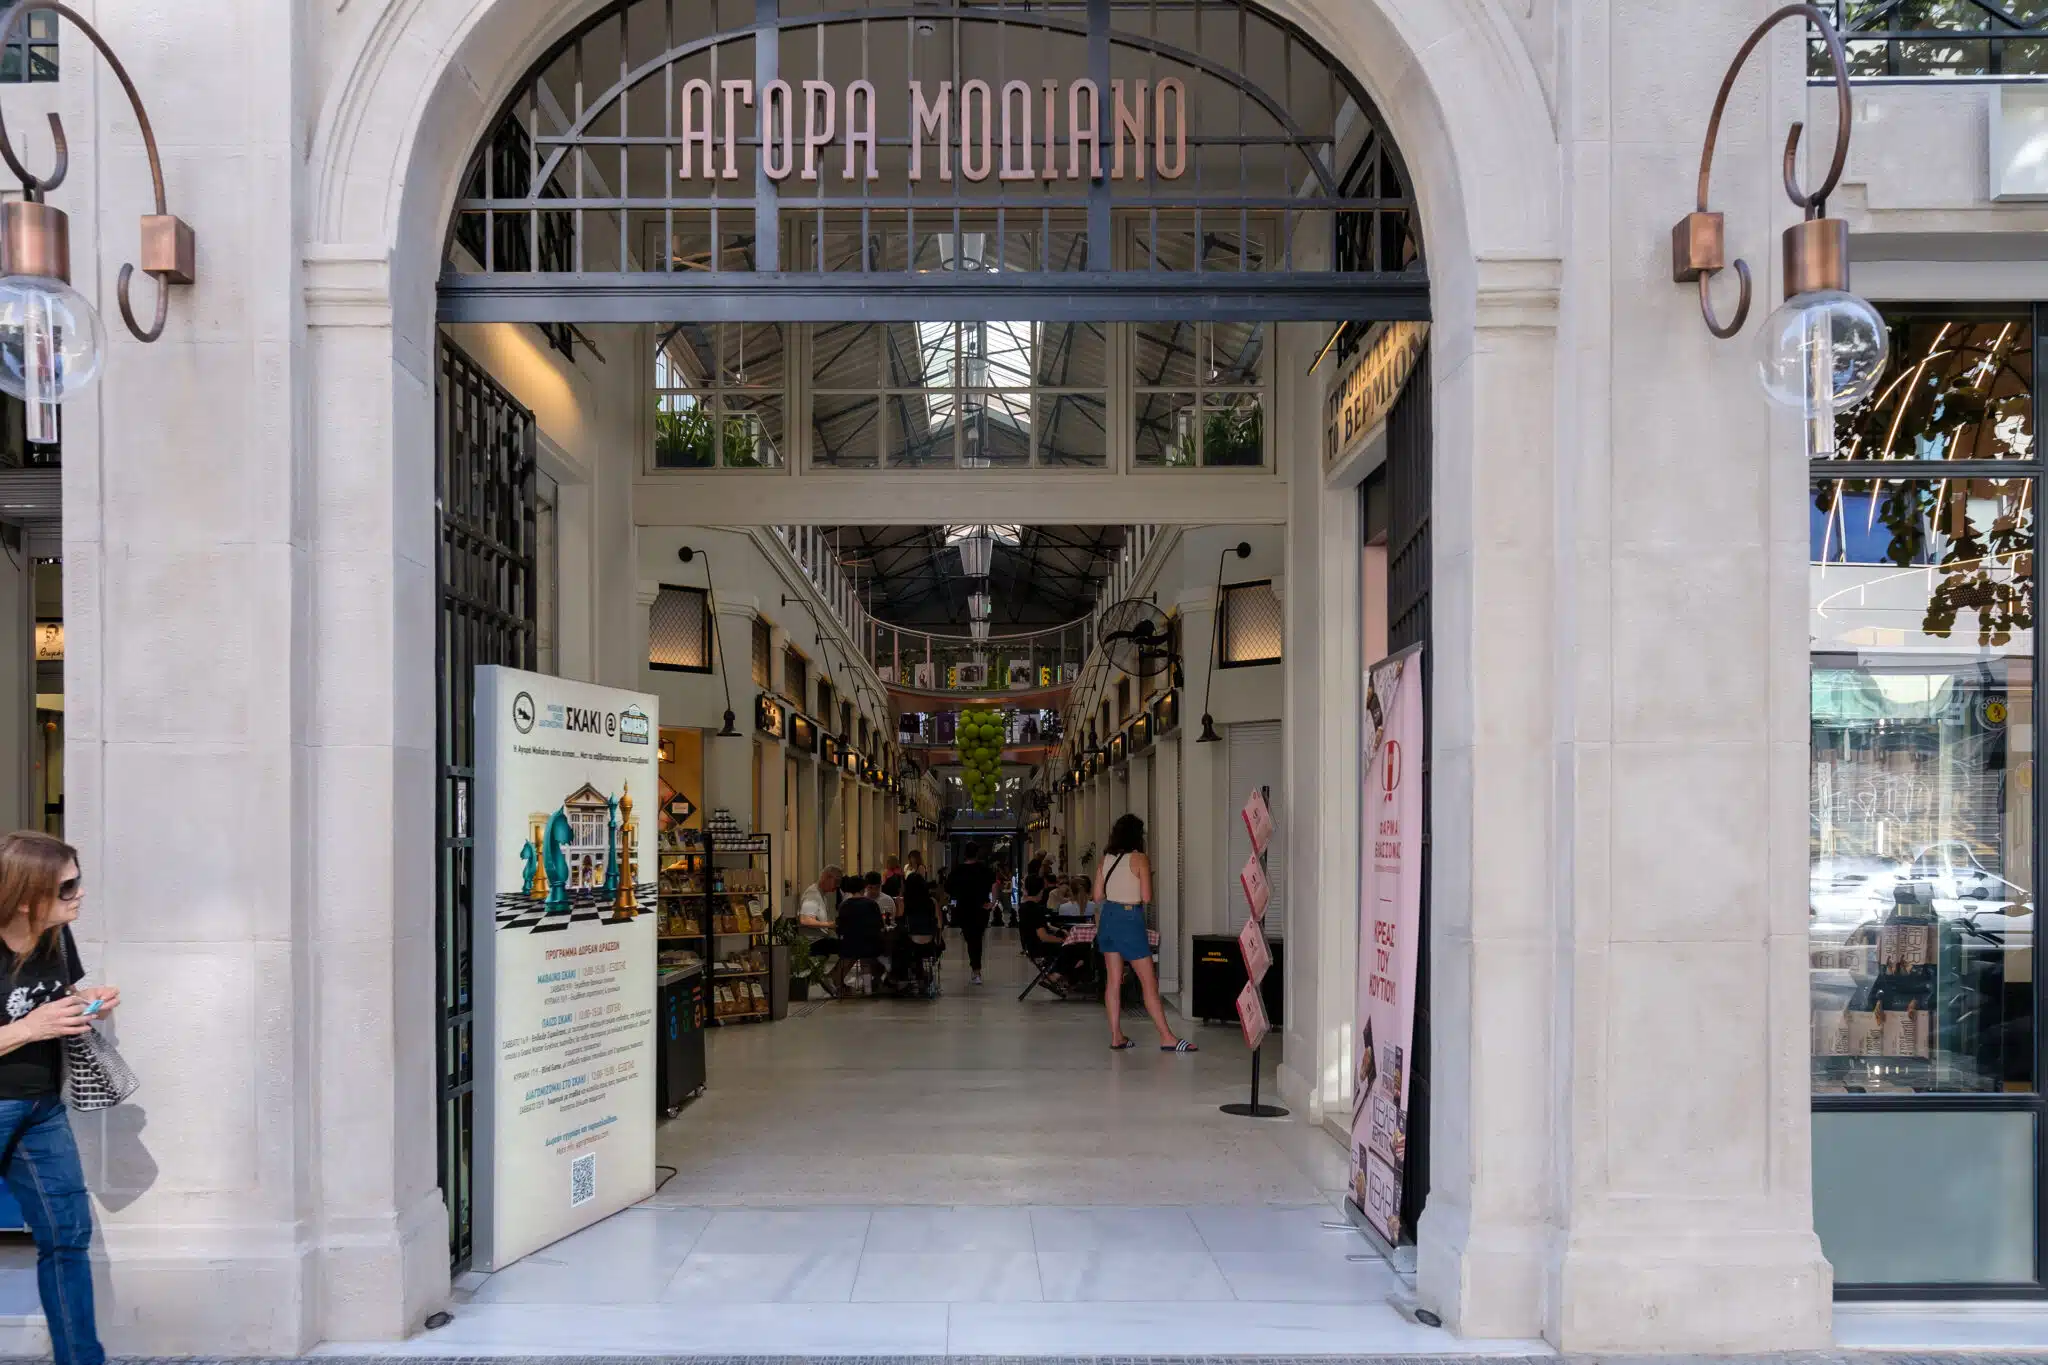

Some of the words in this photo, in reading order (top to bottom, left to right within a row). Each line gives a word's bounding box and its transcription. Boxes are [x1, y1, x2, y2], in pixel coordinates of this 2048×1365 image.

[679, 78, 878, 180] ΑΓΟΡΑ
[909, 77, 1186, 181] ΜΟΔΙΑΝΟ
[566, 707, 601, 734] ΣΚΑΚΙ
[605, 712, 616, 737] @
[1374, 920, 1396, 947] ΚΡΕΑΣ
[546, 948, 577, 960] ΠΡΟΓΡΑΜΜΑ
[579, 944, 598, 955] ΔΩΡΕΑΝ
[1377, 948, 1390, 974] ΤΟΥ
